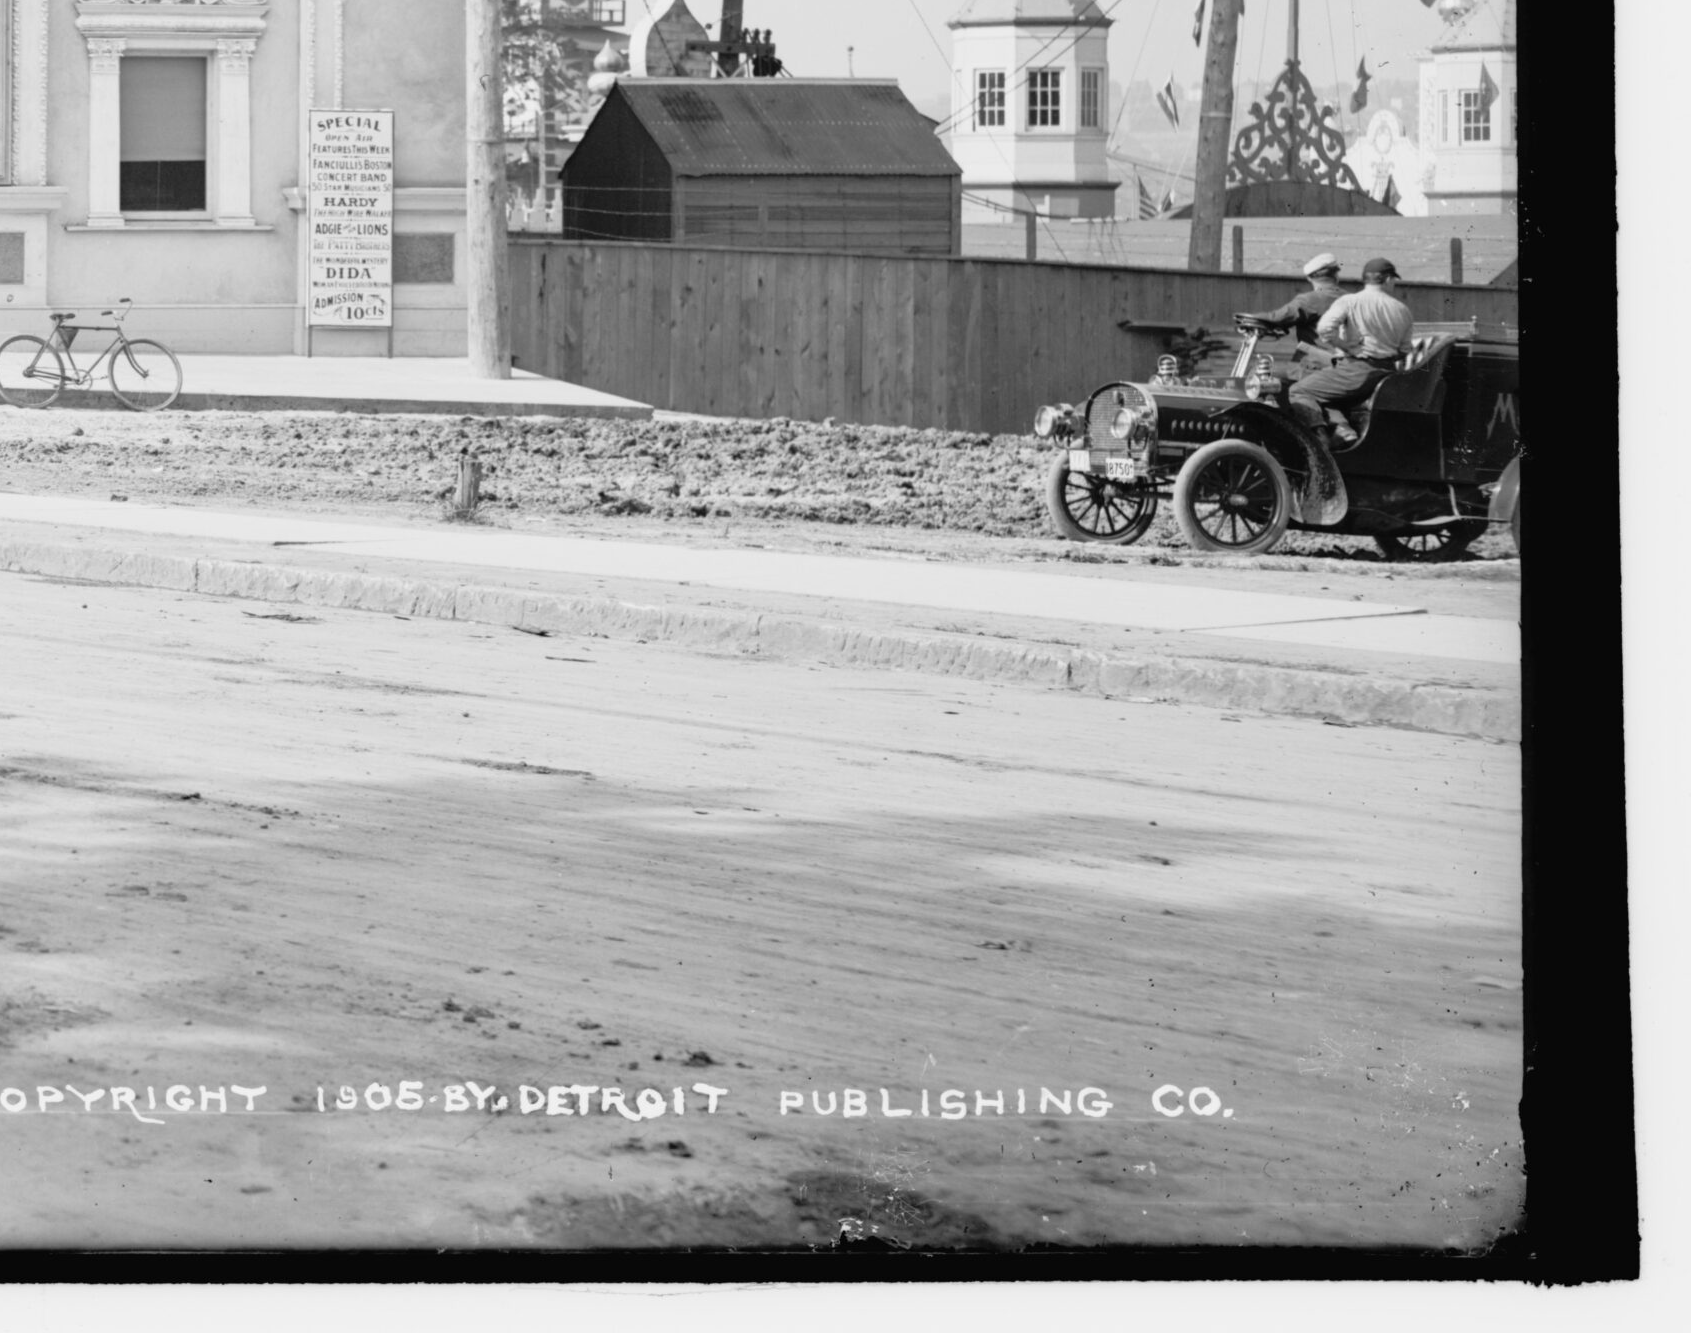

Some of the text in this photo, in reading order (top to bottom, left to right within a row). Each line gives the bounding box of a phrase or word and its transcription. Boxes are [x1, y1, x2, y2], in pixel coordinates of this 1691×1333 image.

[317, 116, 382, 132] SPECIAL
[325, 134, 373, 142] OPEN AIR
[313, 143, 390, 154] FEATURES THIS WEEK
[364, 159, 392, 170] BOSTON
[317, 173, 387, 182] CONCERT BAND
[312, 182, 322, 191] 50
[324, 182, 342, 191] STAR
[324, 197, 378, 207] HARDY
[315, 223, 342, 235] ADGIE
[357, 223, 388, 236] LIONS
[314, 293, 364, 309] ADMISSION
